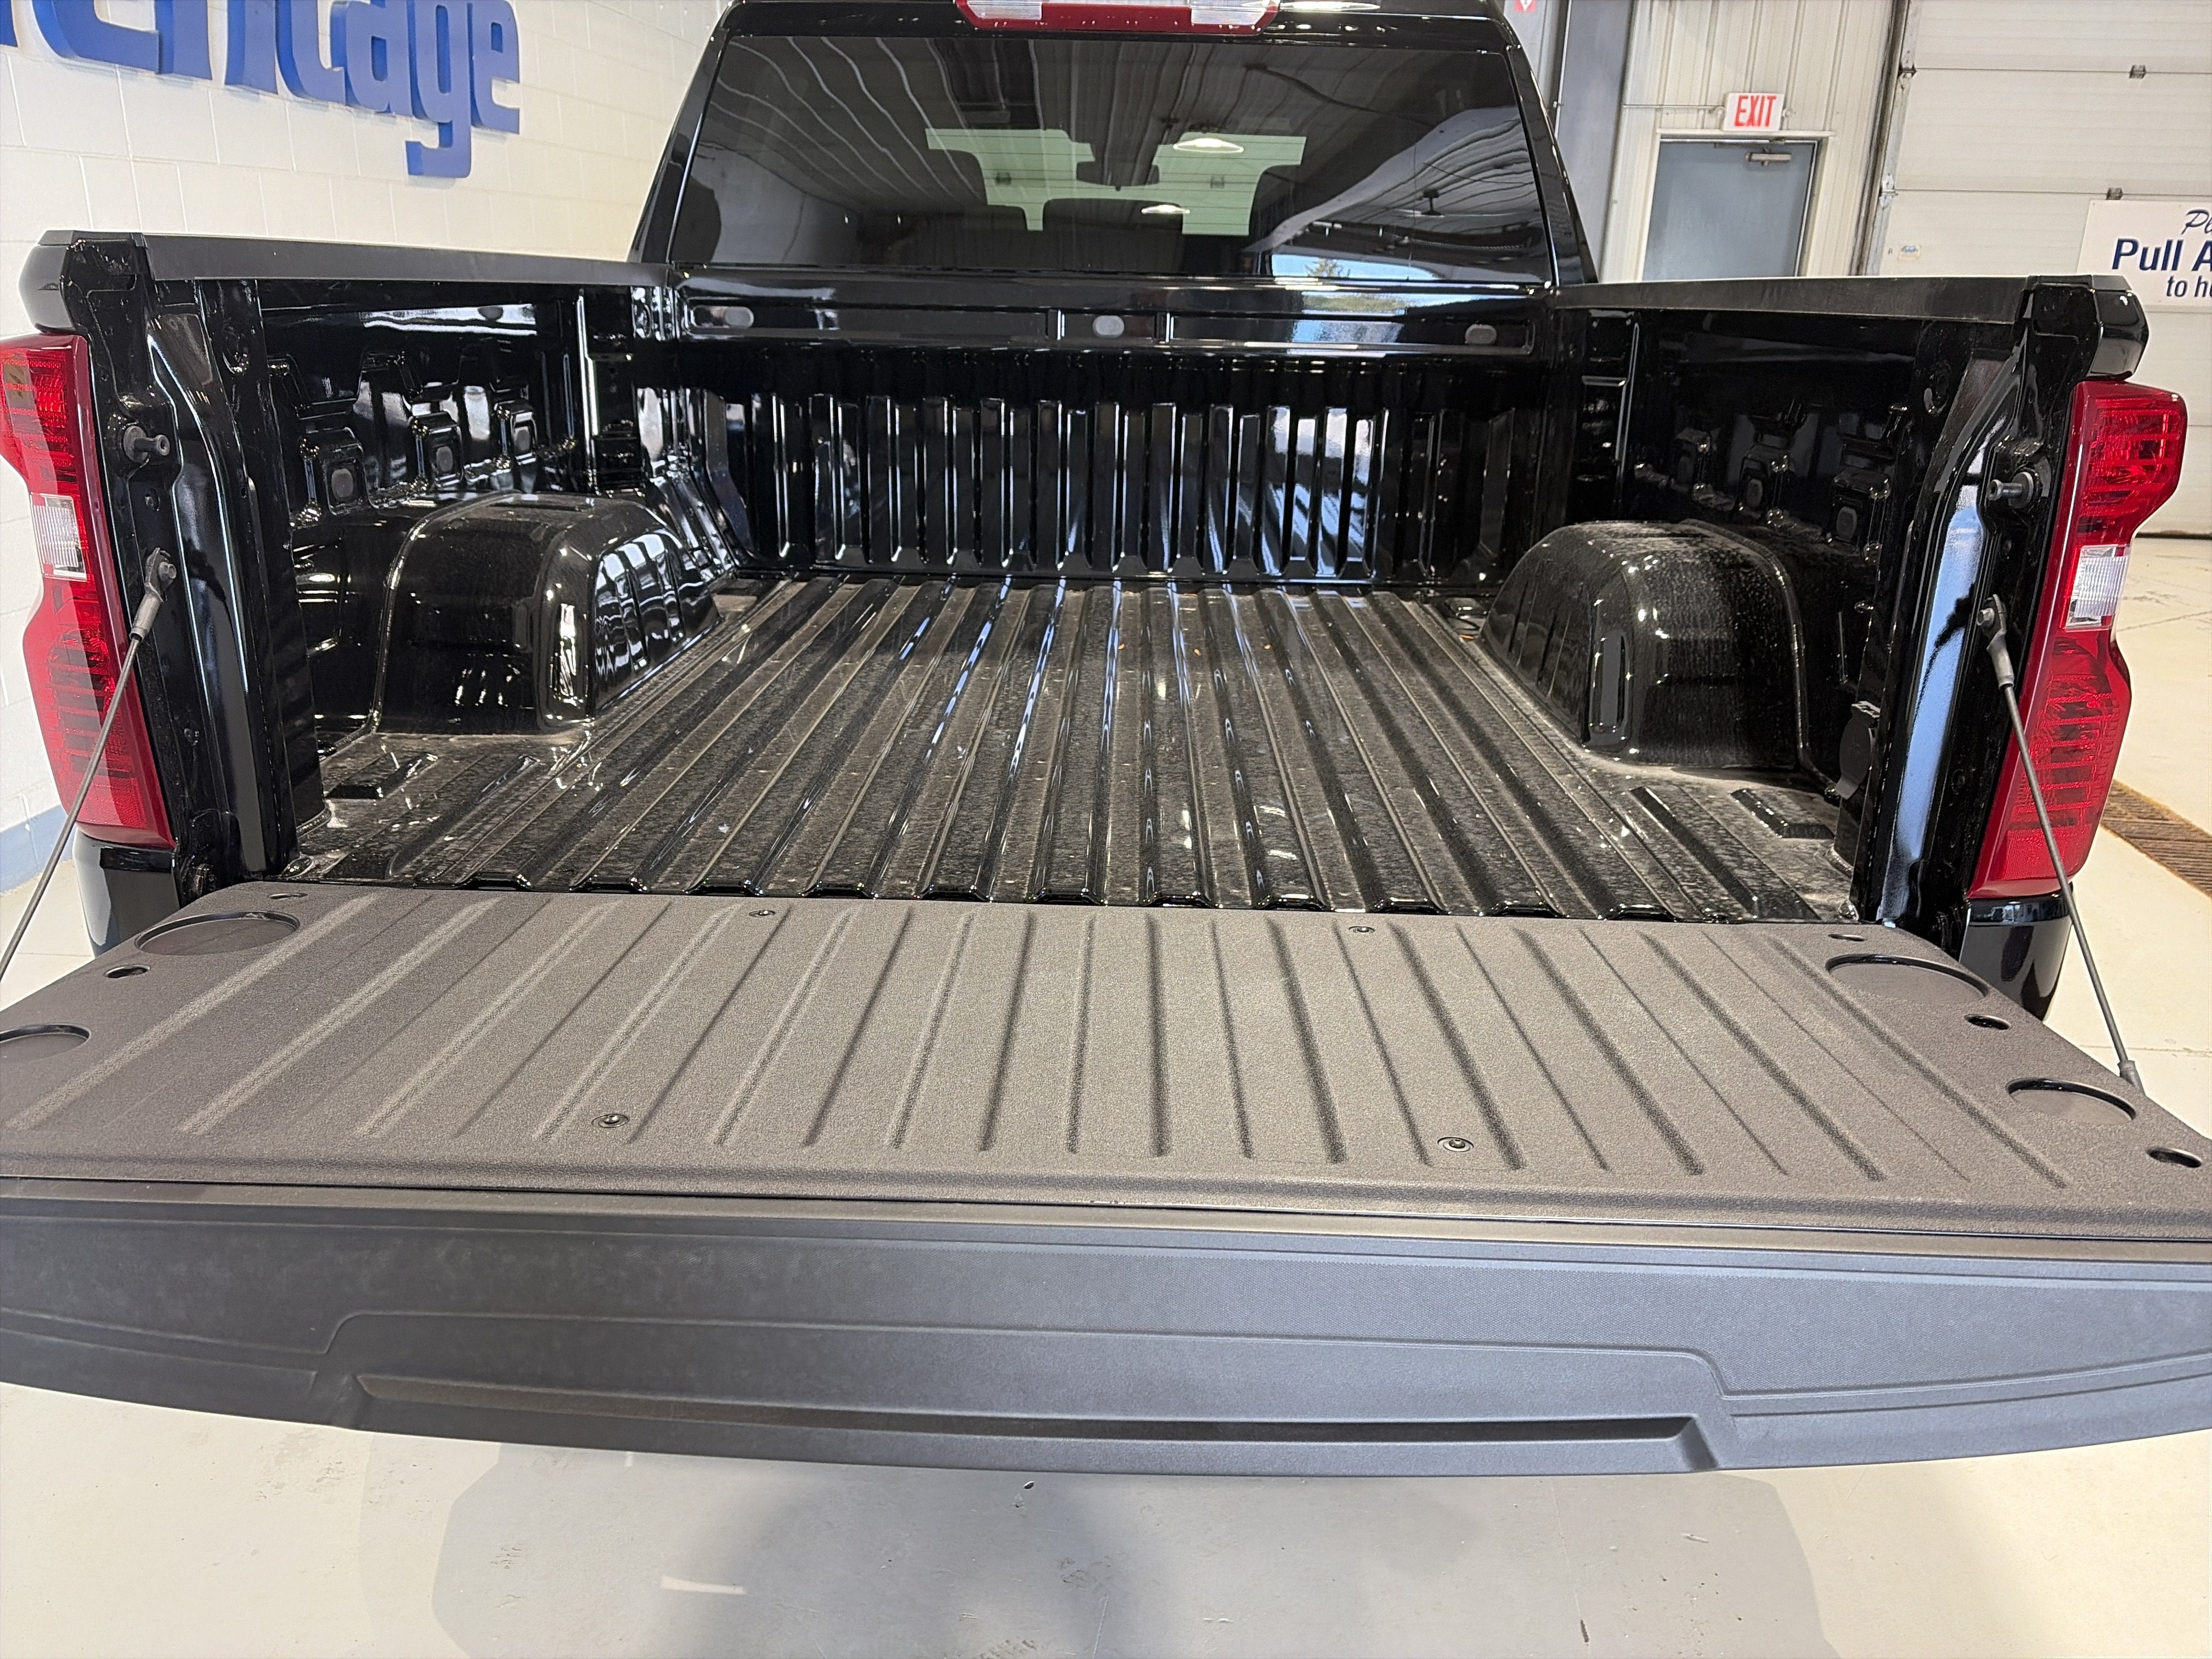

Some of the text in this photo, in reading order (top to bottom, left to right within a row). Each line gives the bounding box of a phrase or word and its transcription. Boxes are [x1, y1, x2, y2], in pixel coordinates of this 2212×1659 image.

[1734, 95, 1777, 127] EXIT
[2112, 238, 2184, 271] Pull
[2166, 275, 2212, 297] to h
